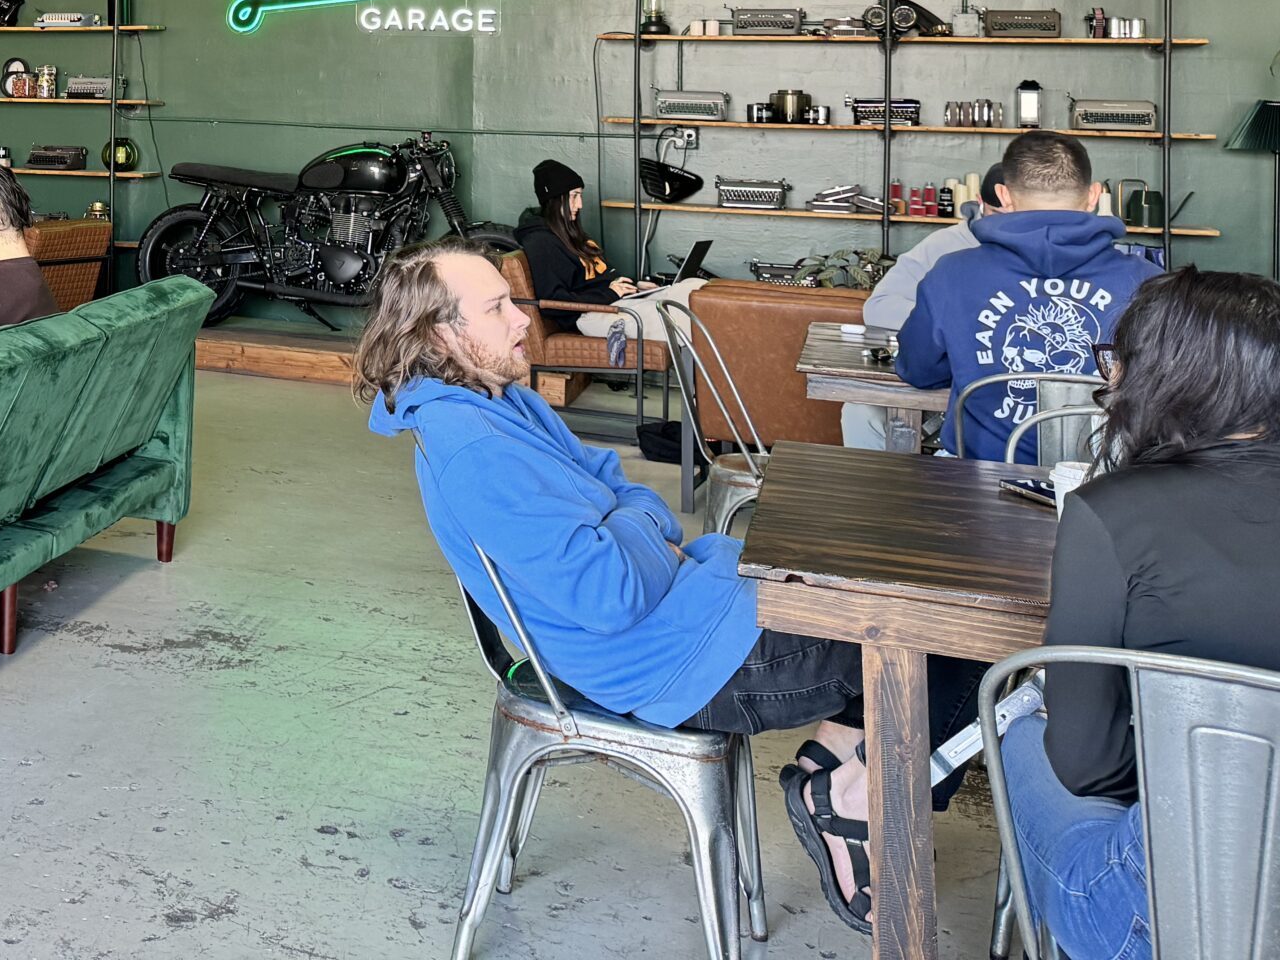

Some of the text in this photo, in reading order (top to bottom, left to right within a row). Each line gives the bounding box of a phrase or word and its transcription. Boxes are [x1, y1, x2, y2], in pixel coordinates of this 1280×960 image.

[359, 7, 498, 33] GARAGE
[976, 277, 1113, 365] EARN YOUR
